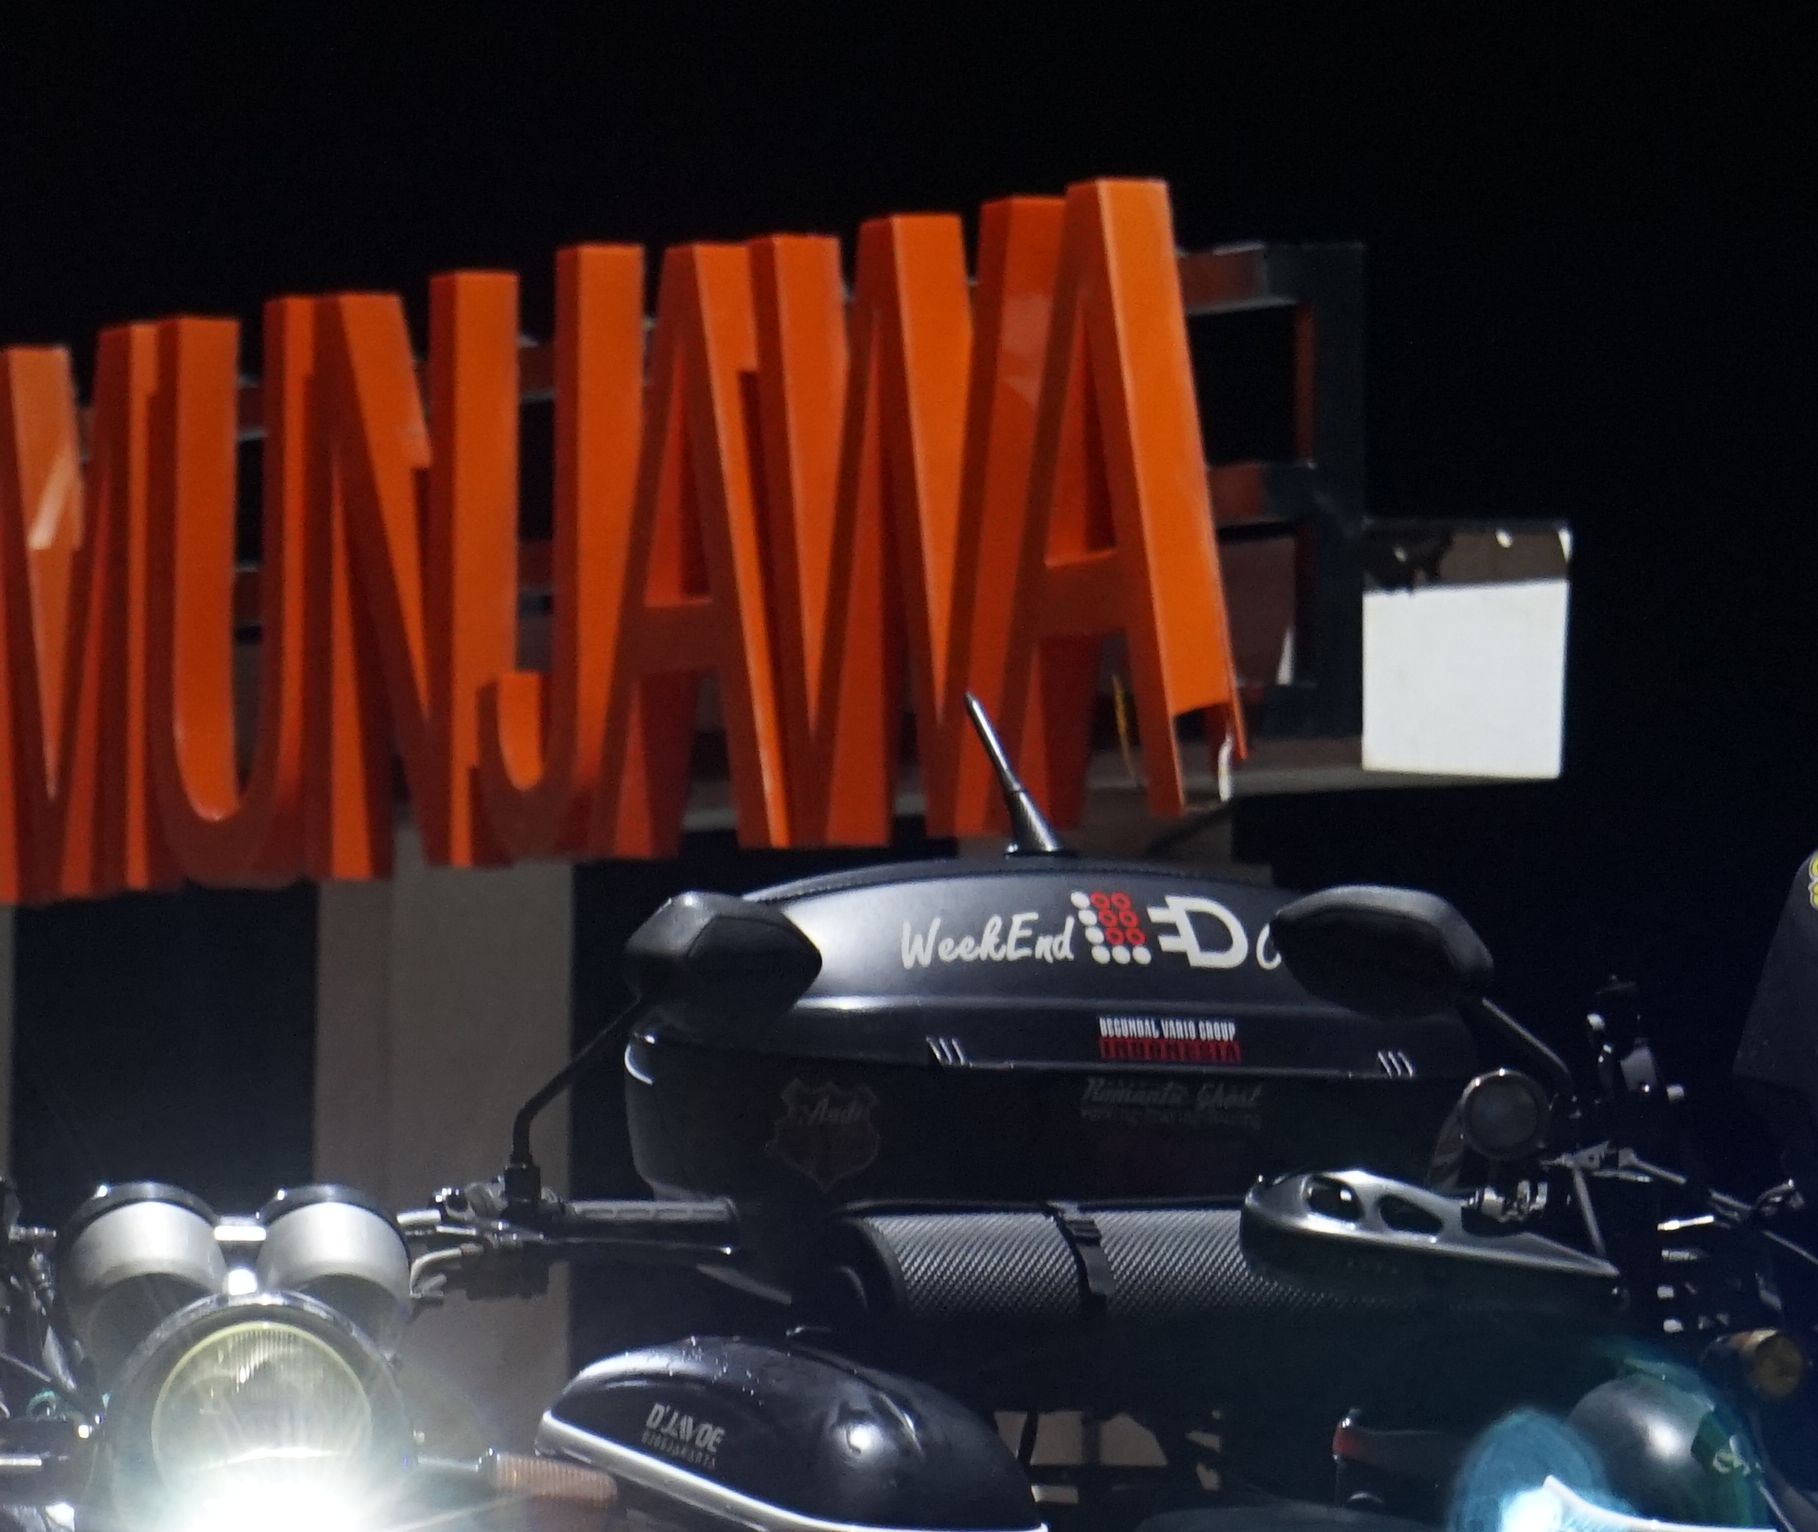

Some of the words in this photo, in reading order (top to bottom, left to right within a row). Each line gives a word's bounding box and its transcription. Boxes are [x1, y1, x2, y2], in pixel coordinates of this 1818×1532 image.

[901, 914, 1075, 969] WeekEnd
[1160, 1018, 1196, 1040] VARIO
[1198, 1019, 1236, 1042] GROUP
